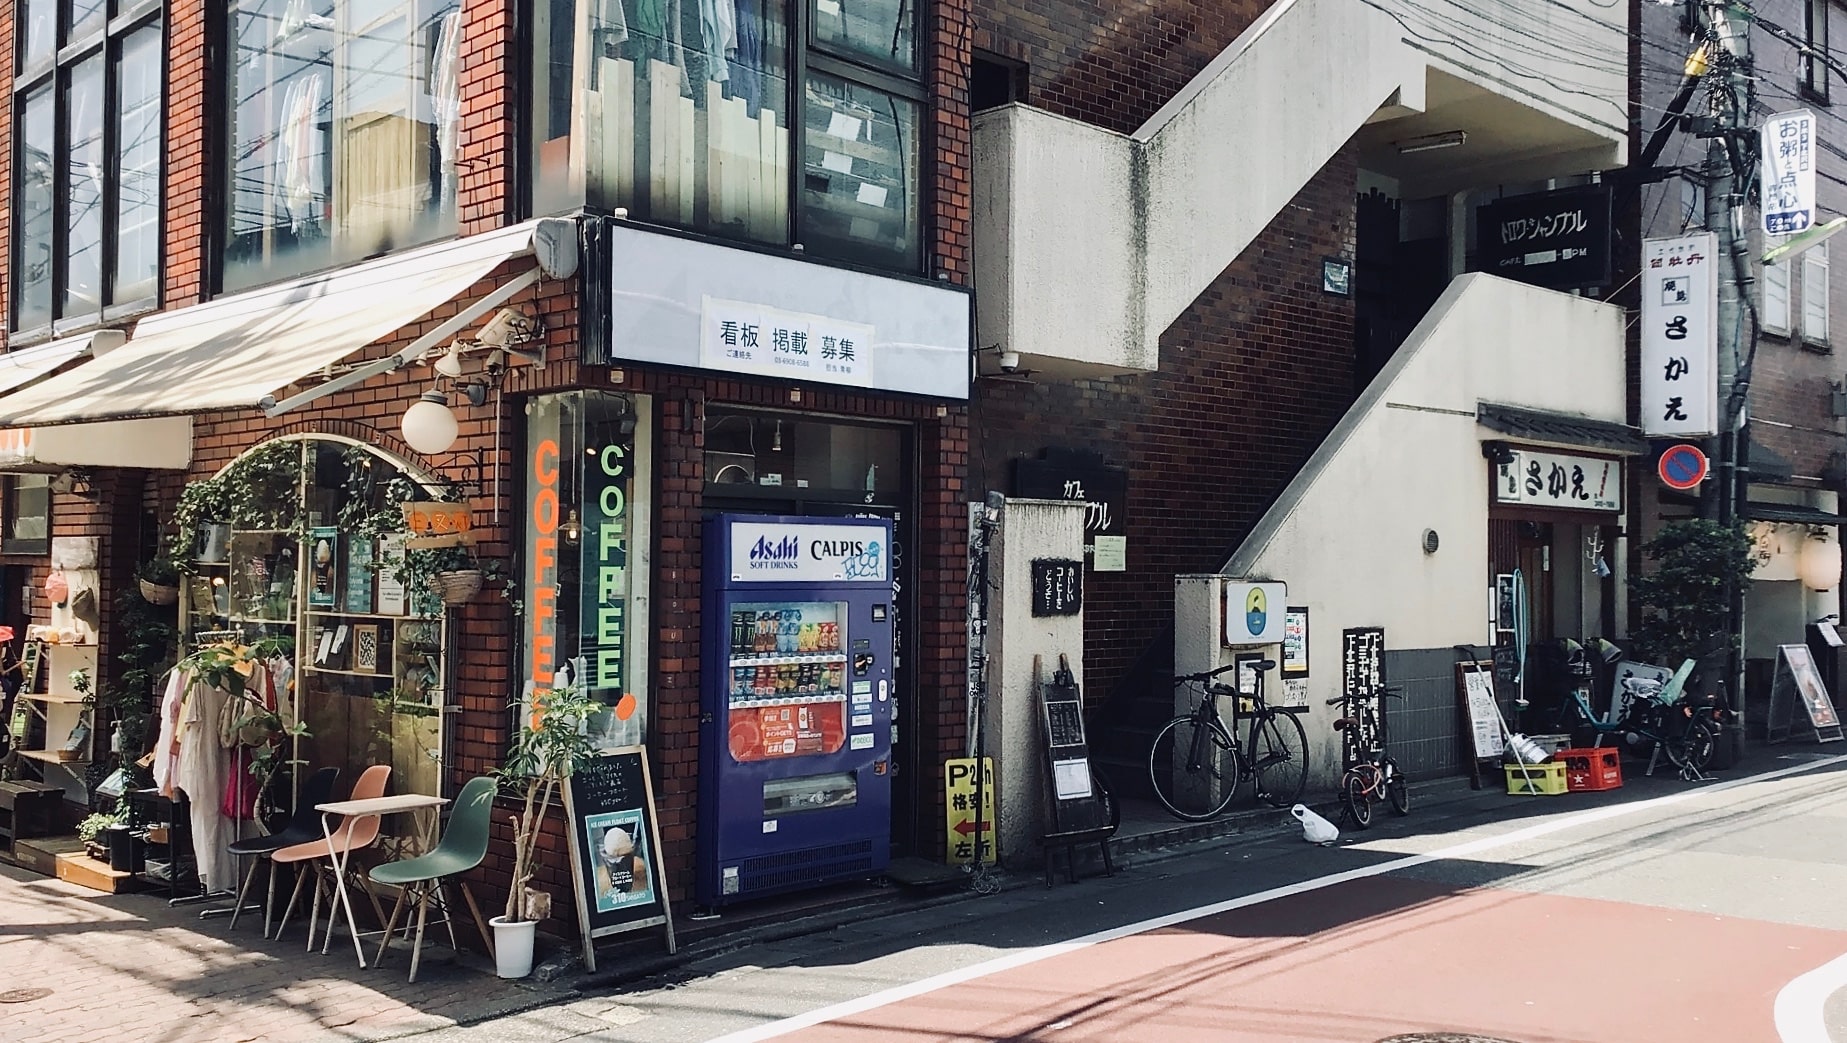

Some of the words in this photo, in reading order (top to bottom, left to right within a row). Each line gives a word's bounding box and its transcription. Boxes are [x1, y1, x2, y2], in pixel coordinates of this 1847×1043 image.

[720, 320, 759, 348] 看板
[772, 327, 808, 356] 掲載
[821, 335, 856, 362] 募集
[1664, 315, 1688, 422] さかえ
[1063, 479, 1085, 499] カフェ
[1525, 460, 1590, 501] さかえ
[750, 534, 799, 560] Asahi
[810, 539, 863, 560] CALPIS
[597, 444, 625, 690] COFFEE
[750, 561, 769, 570] SOFT
[770, 561, 798, 570] DRINKS
[948, 764, 969, 788] P
[969, 764, 991, 786] 2h
